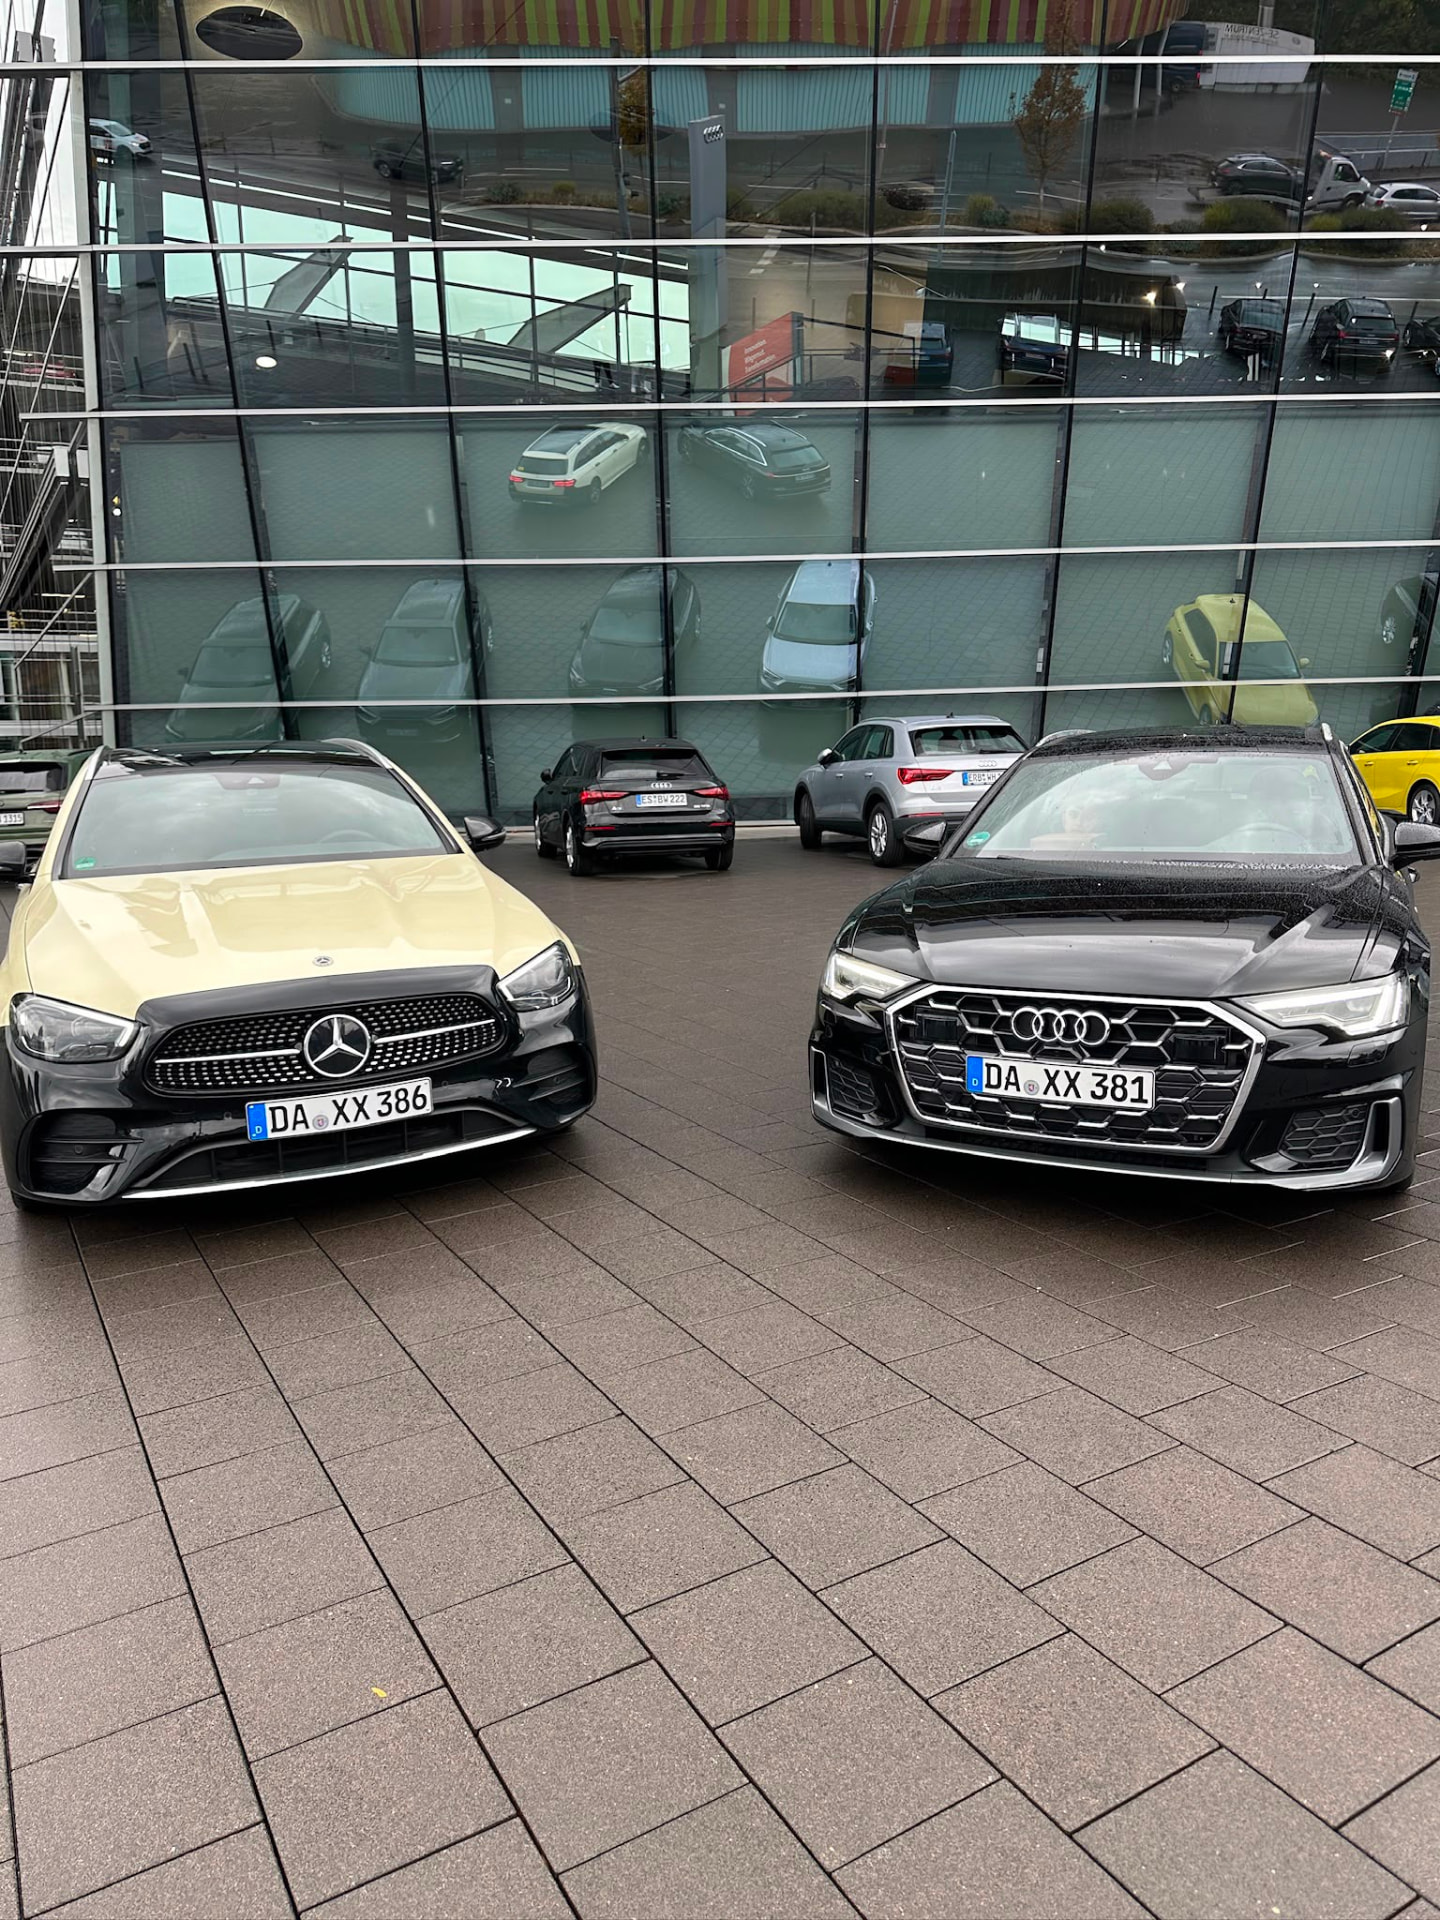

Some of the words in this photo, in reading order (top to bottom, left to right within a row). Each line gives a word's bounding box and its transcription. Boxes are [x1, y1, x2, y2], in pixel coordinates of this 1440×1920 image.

[641, 795, 652, 804] ES
[657, 795, 668, 803] BW
[670, 794, 685, 803] 222
[972, 1078, 979, 1086] D
[985, 1063, 1021, 1092] DA
[1043, 1069, 1081, 1098] XX
[1090, 1072, 1148, 1104] 381
[269, 1104, 309, 1133] DA
[332, 1095, 370, 1126] XX
[377, 1085, 427, 1117] 386
[255, 1125, 263, 1134] D
